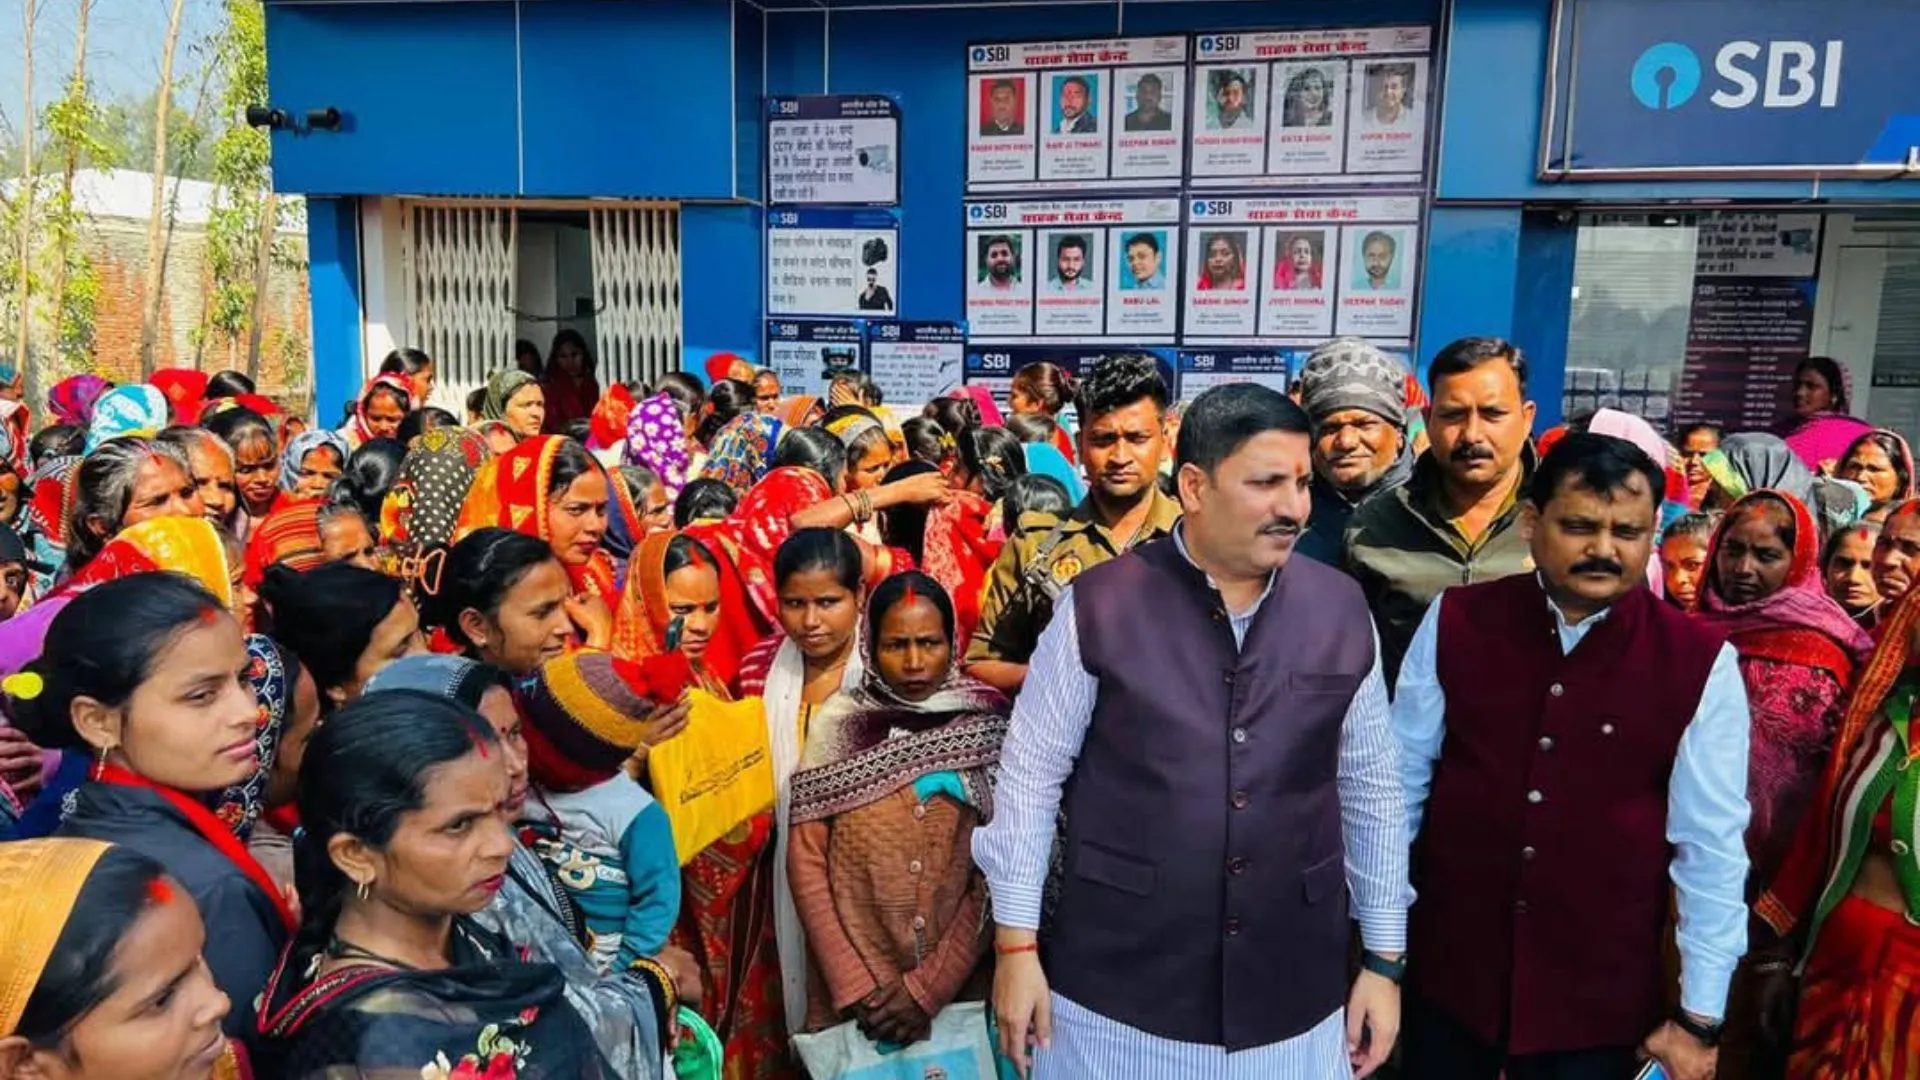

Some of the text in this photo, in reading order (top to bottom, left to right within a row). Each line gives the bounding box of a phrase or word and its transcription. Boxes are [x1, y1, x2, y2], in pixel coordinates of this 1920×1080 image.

[1215, 36, 1240, 52] SBI
[987, 46, 1010, 62] SBI
[1710, 40, 1843, 109] SBI
[780, 101, 798, 113] SBI
[984, 205, 1007, 219] SBI
[1208, 201, 1232, 215] SBI
[781, 212, 798, 224] SBI
[780, 324, 798, 336] SBI
[881, 325, 900, 337] SBI
[983, 353, 1010, 369] SBI
[1194, 355, 1215, 368] SBI
